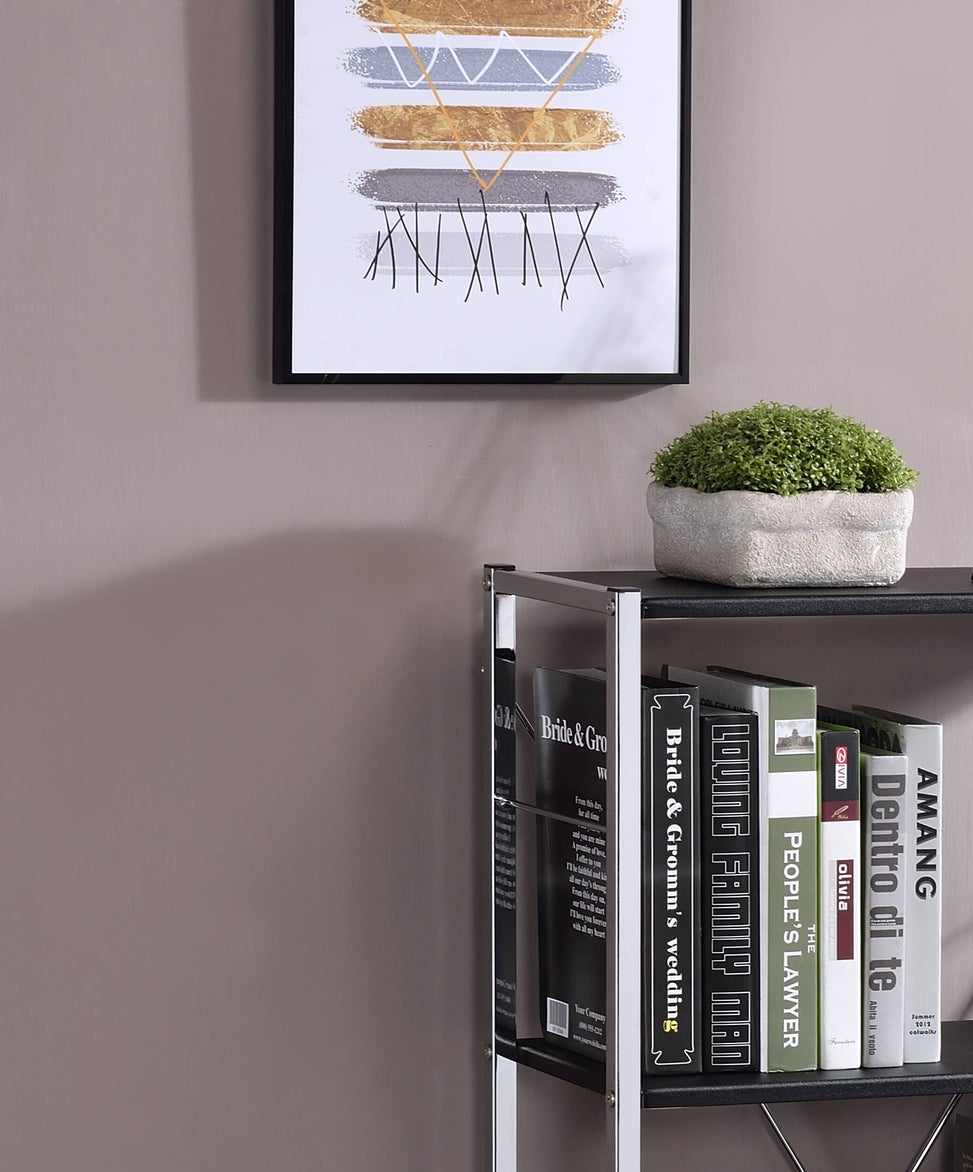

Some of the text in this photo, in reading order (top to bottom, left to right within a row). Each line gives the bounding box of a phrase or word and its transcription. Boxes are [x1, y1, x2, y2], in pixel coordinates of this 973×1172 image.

[541, 714, 573, 744] Bride
[573, 722, 584, 748] &
[711, 724, 750, 837] LOVING
[662, 727, 683, 1033] Bride & Gromm's wedding
[838, 864, 853, 912] olivia
[870, 774, 906, 893] Dentro
[915, 767, 938, 900] AMANG
[711, 852, 751, 976] FAMILY
[783, 831, 803, 1049] PEOPLE'S LAWYER
[807, 924, 816, 953] THE
[869, 906, 904, 939] di
[868, 957, 902, 992] te
